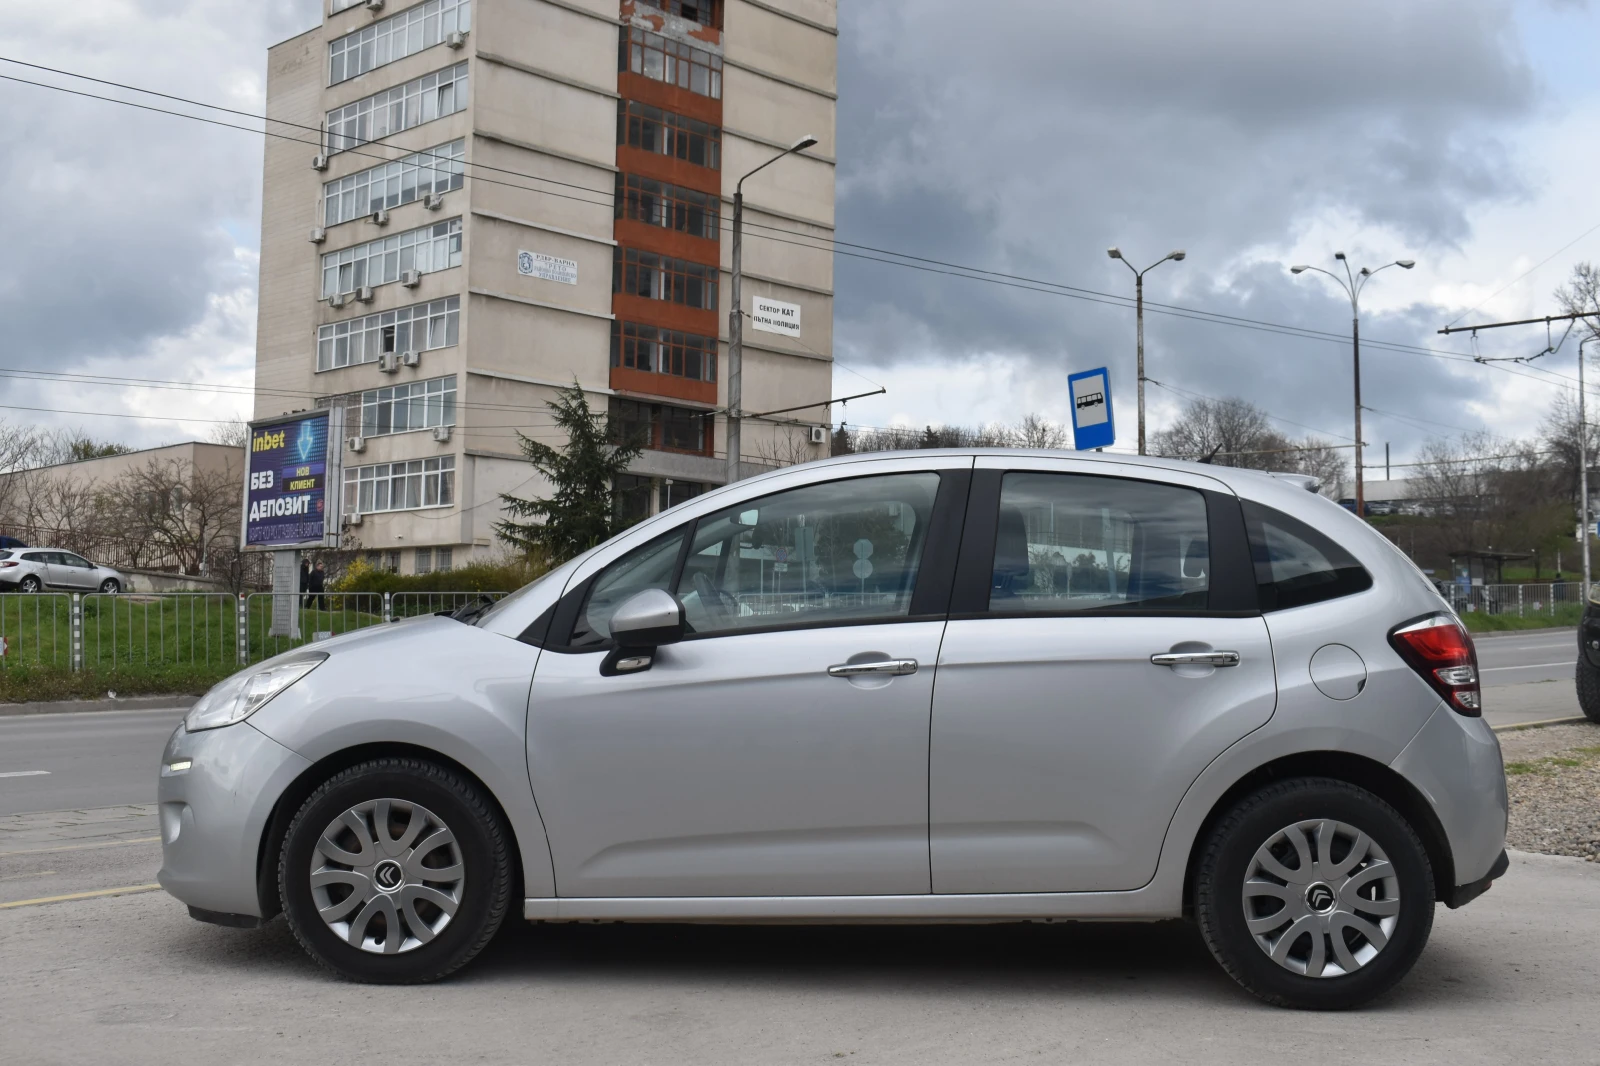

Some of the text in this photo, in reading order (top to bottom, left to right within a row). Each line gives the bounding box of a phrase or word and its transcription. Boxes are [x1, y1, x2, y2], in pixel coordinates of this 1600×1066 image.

[759, 304, 795, 317] СЕКТОР КАТ
[772, 319, 800, 330] ПОЛИЦИЯ
[252, 430, 285, 452] inbet
[296, 466, 310, 477] НОВ
[250, 470, 274, 490] БЕЗ
[289, 478, 315, 491] КЛИЕНТ
[249, 495, 311, 522] ДЕПОЗИТ
